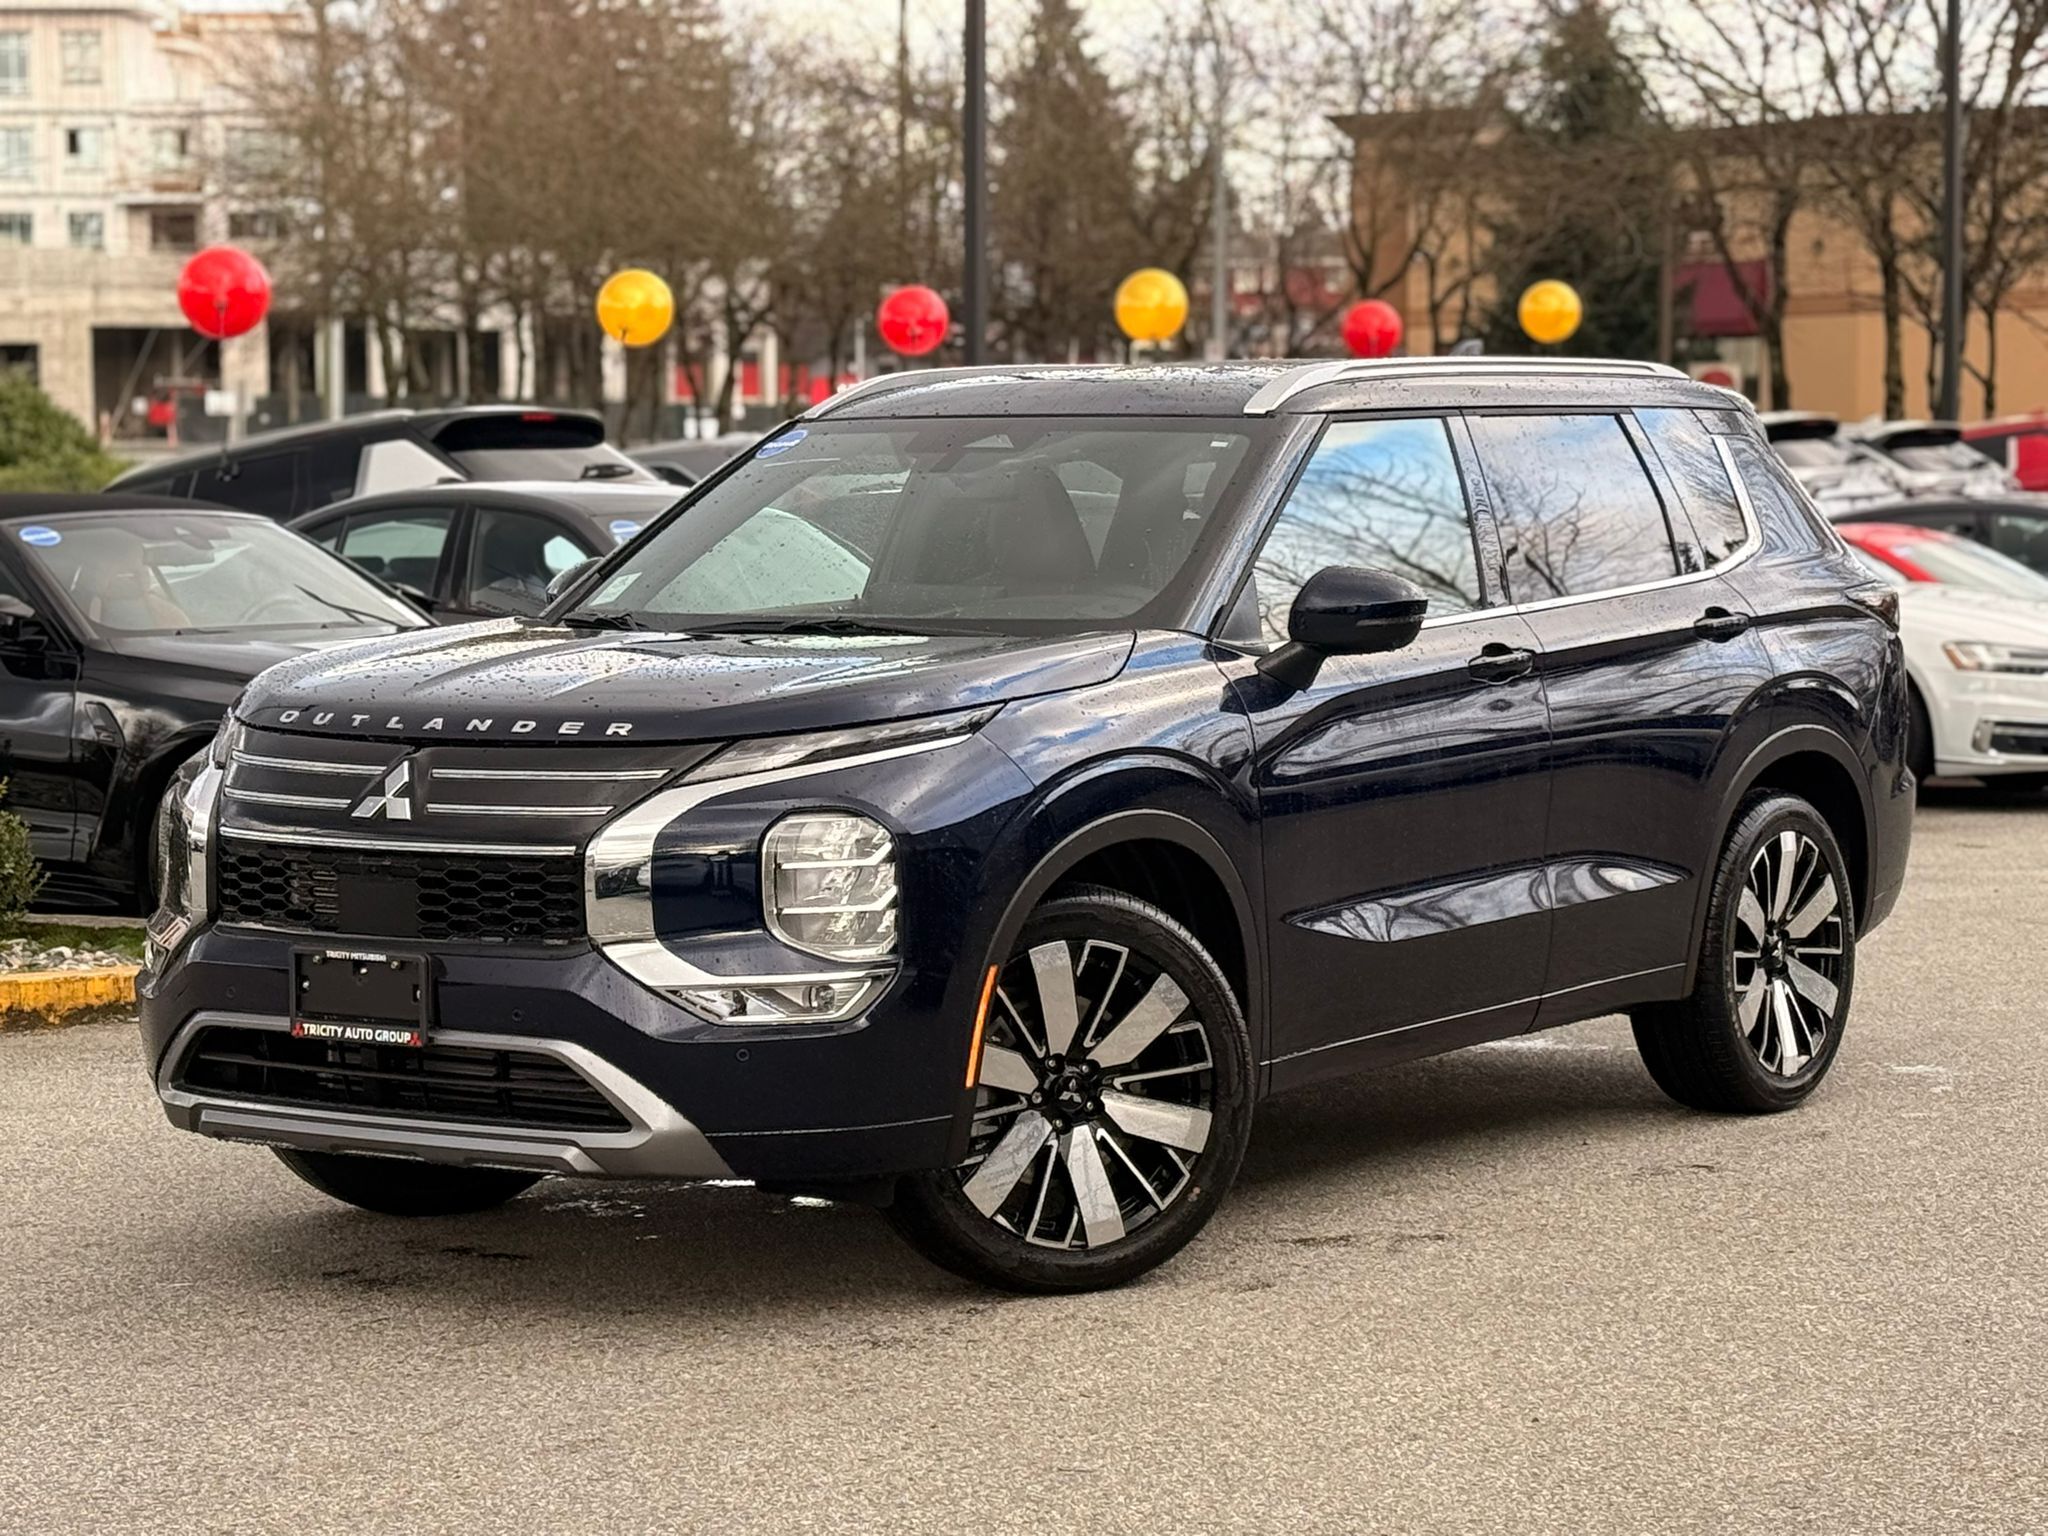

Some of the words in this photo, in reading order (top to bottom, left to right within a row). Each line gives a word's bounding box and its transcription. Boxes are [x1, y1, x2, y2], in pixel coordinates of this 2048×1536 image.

[279, 710, 635, 737] OUTLANDER
[326, 950, 350, 960] TRICITY
[302, 1023, 343, 1037] TRICITY
[344, 1027, 373, 1040] AUTO
[375, 1029, 411, 1044] GROUP
